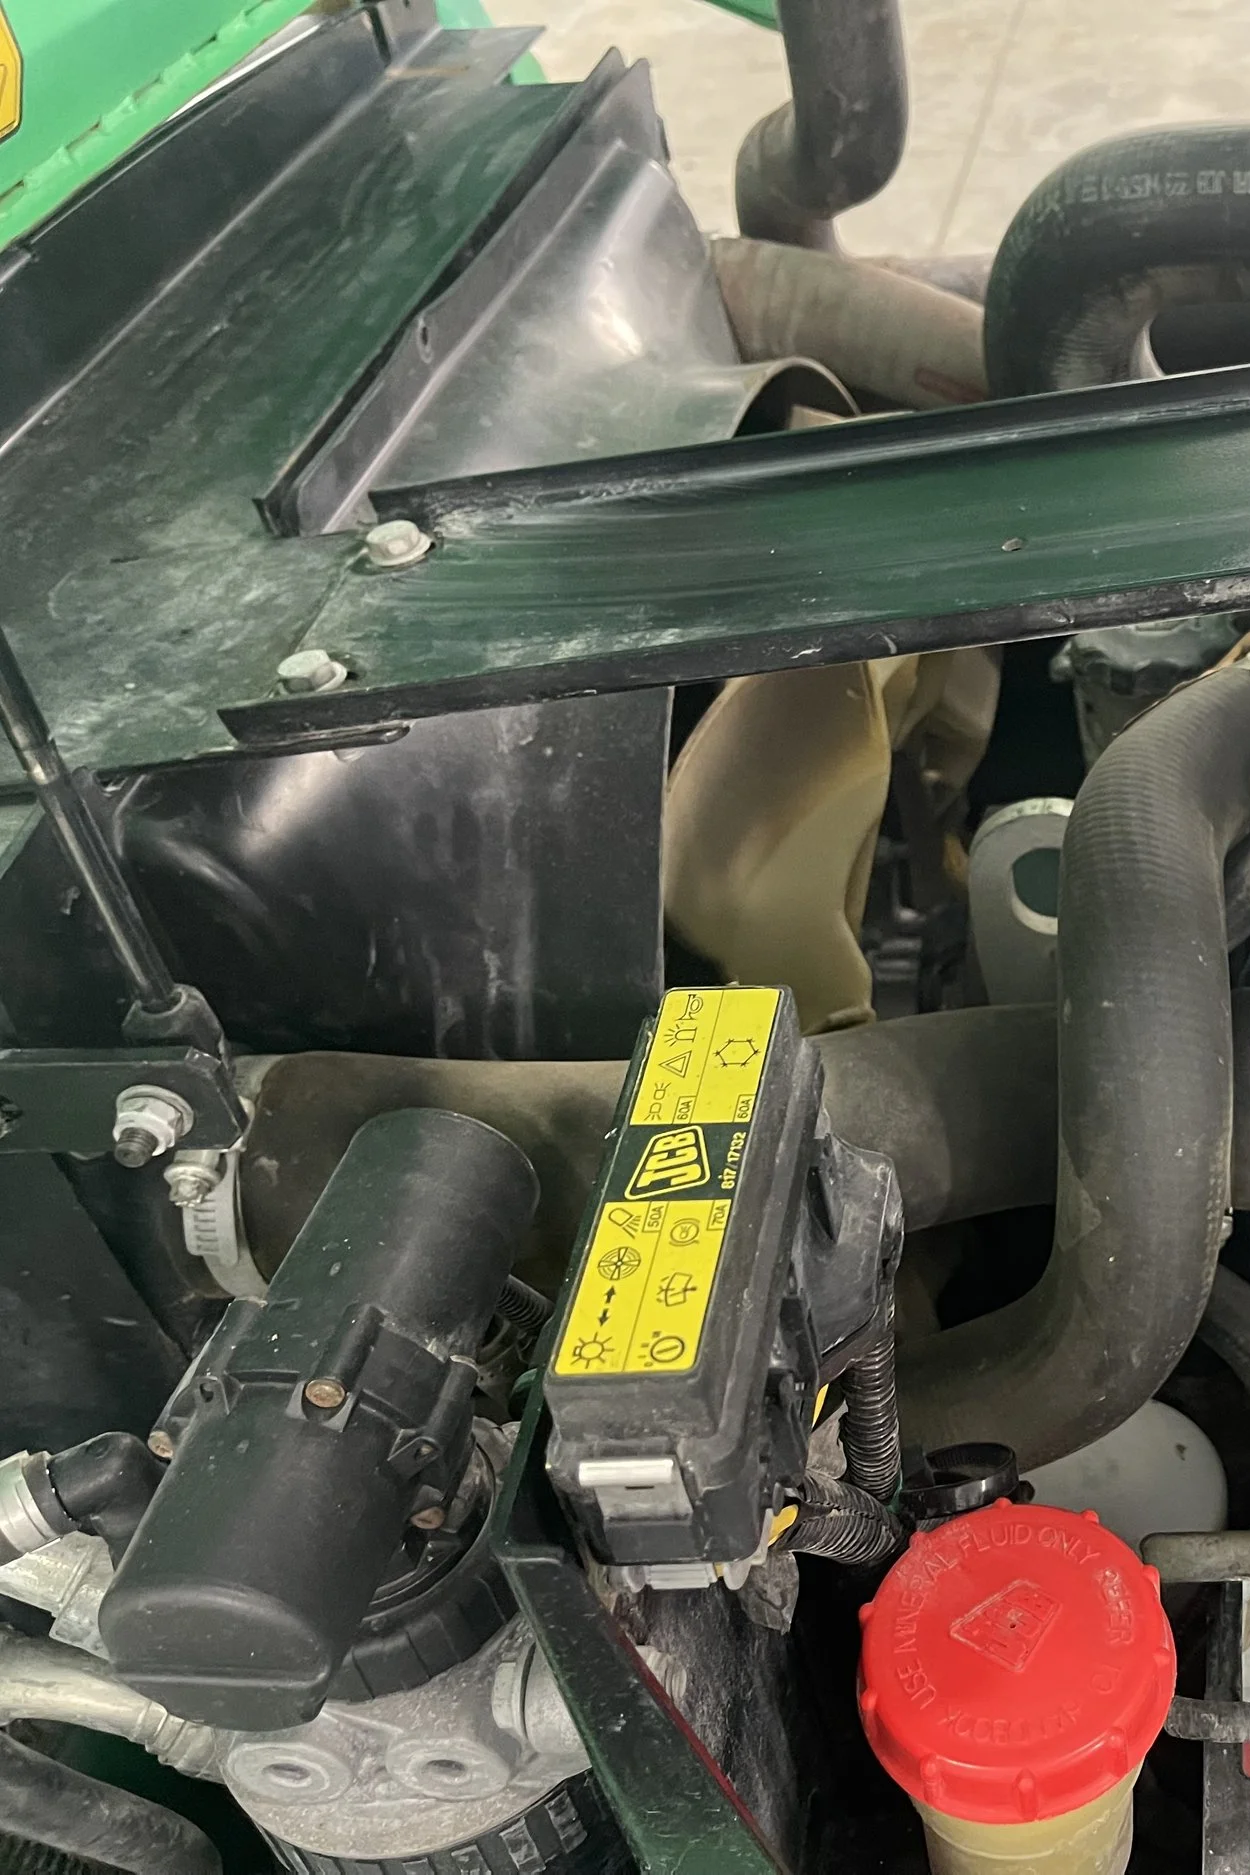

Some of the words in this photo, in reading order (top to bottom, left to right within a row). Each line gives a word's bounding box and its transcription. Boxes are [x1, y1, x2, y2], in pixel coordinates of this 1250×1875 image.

[676, 1098, 693, 1120] 60A
[736, 1098, 751, 1119] 60A
[636, 1131, 702, 1189] JCB
[648, 1205, 663, 1228] 50A
[711, 1204, 727, 1227] 70A
[957, 1523, 1033, 1560] FLUID
[1037, 1526, 1101, 1566] ONLY
[892, 1551, 959, 1655] MINERAL
[896, 1656, 938, 1711] USE
